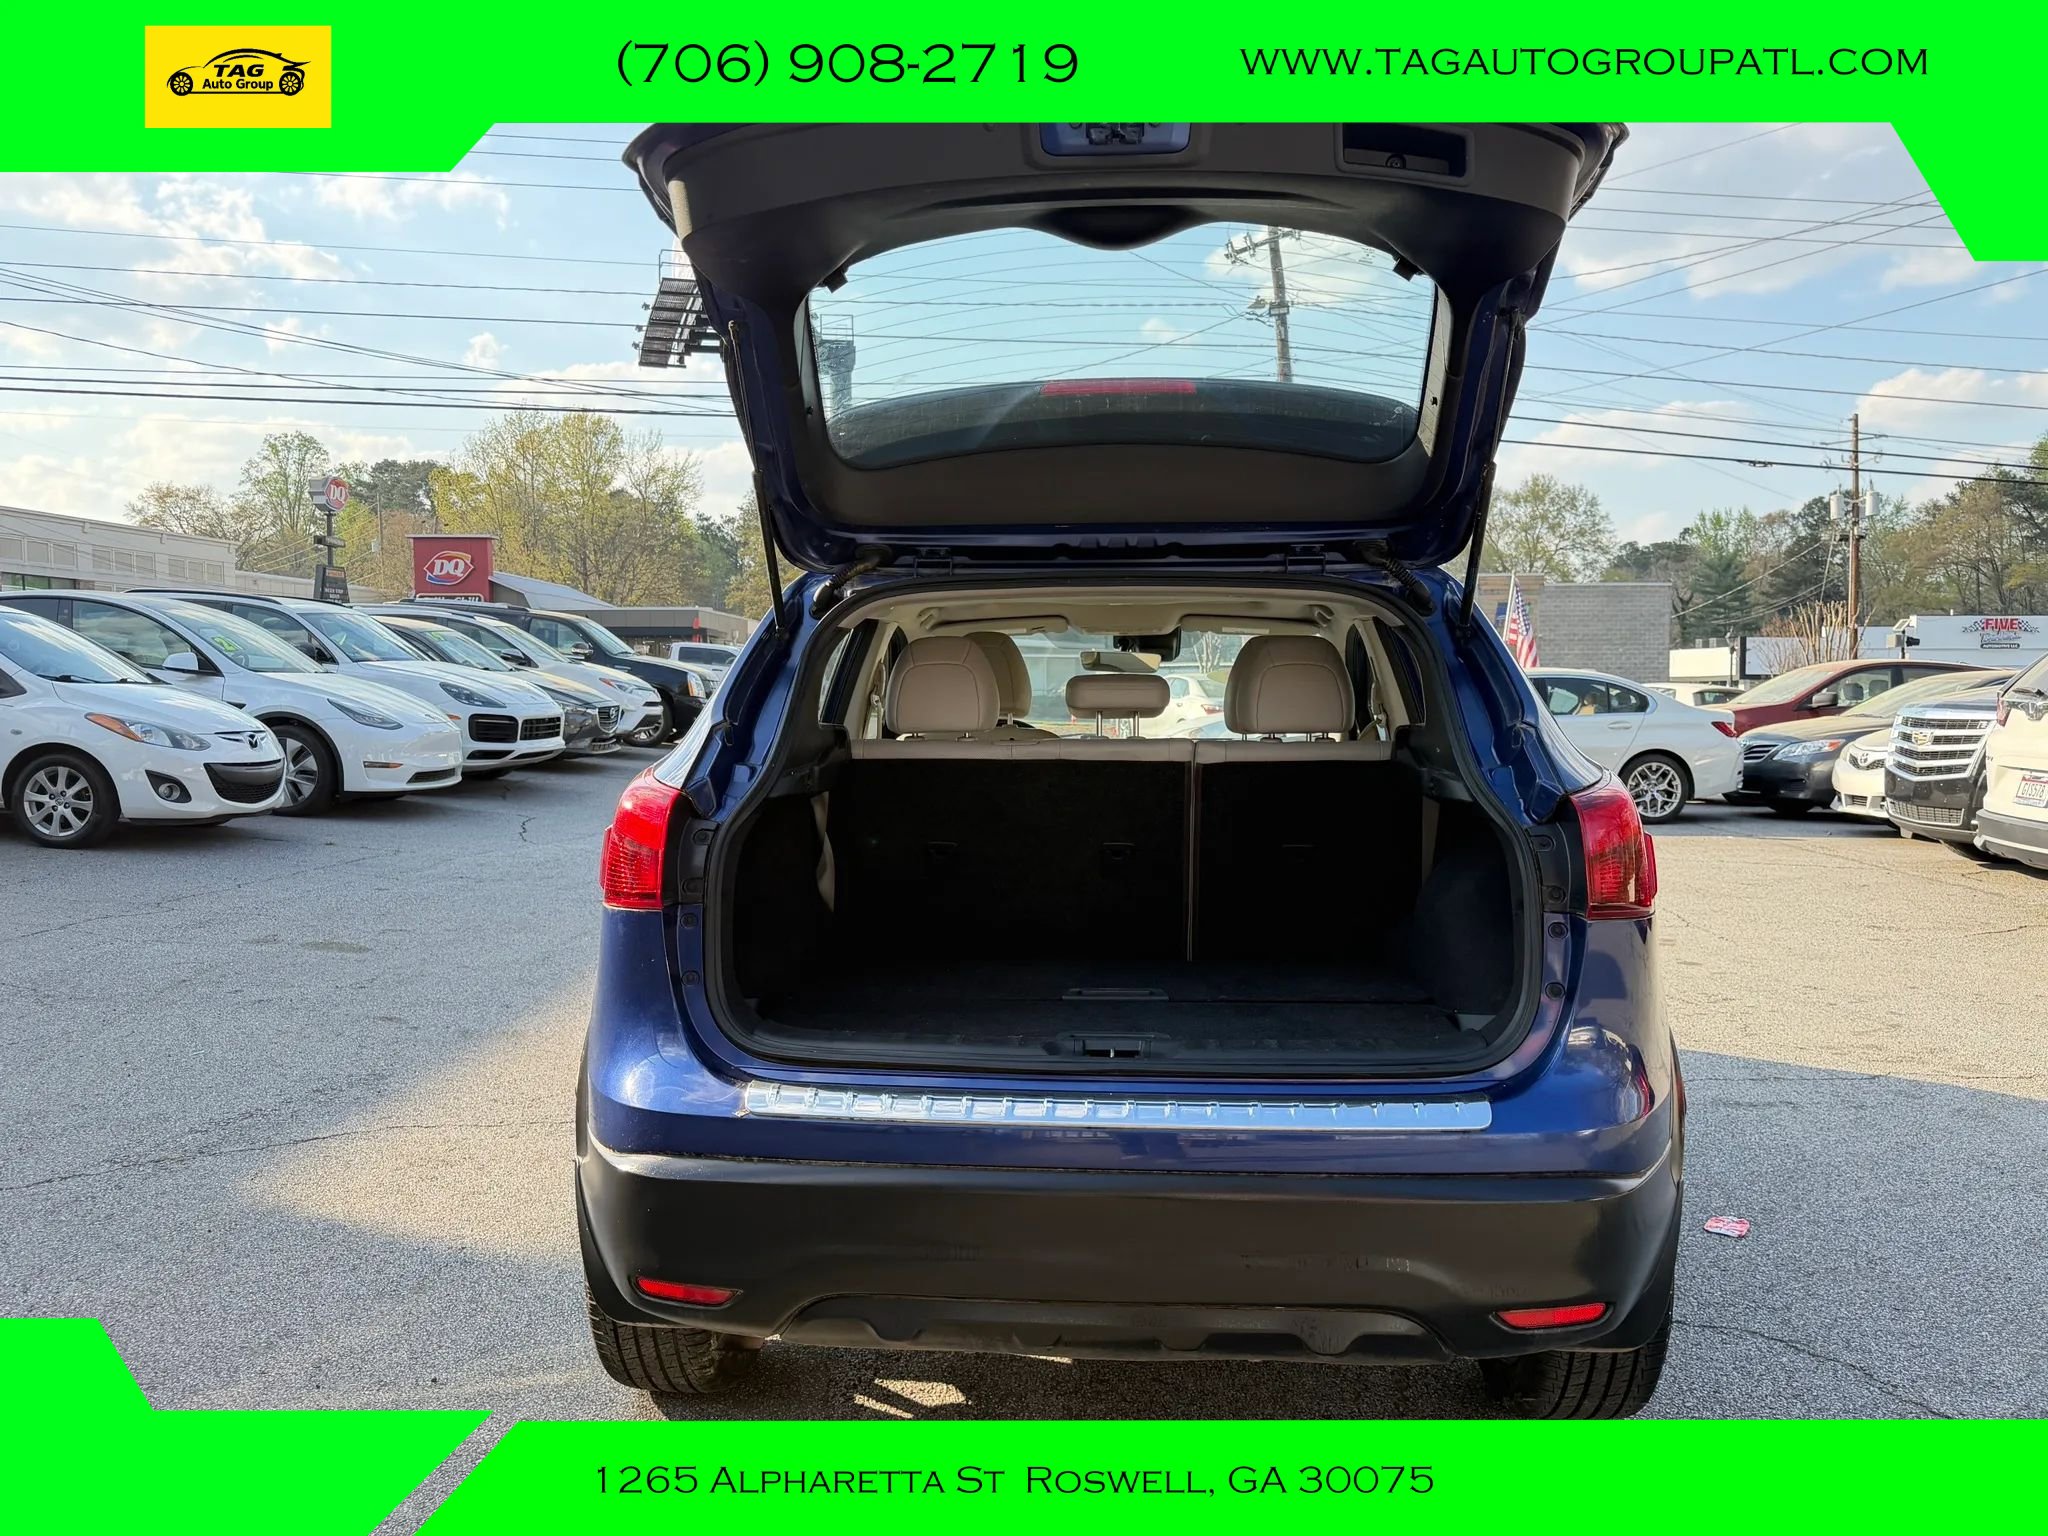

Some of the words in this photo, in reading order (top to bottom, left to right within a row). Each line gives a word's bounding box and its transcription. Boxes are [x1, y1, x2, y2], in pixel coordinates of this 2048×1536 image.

[330, 484, 346, 504] DQ
[432, 558, 465, 577] DQ
[1984, 617, 2019, 631] FIVE
